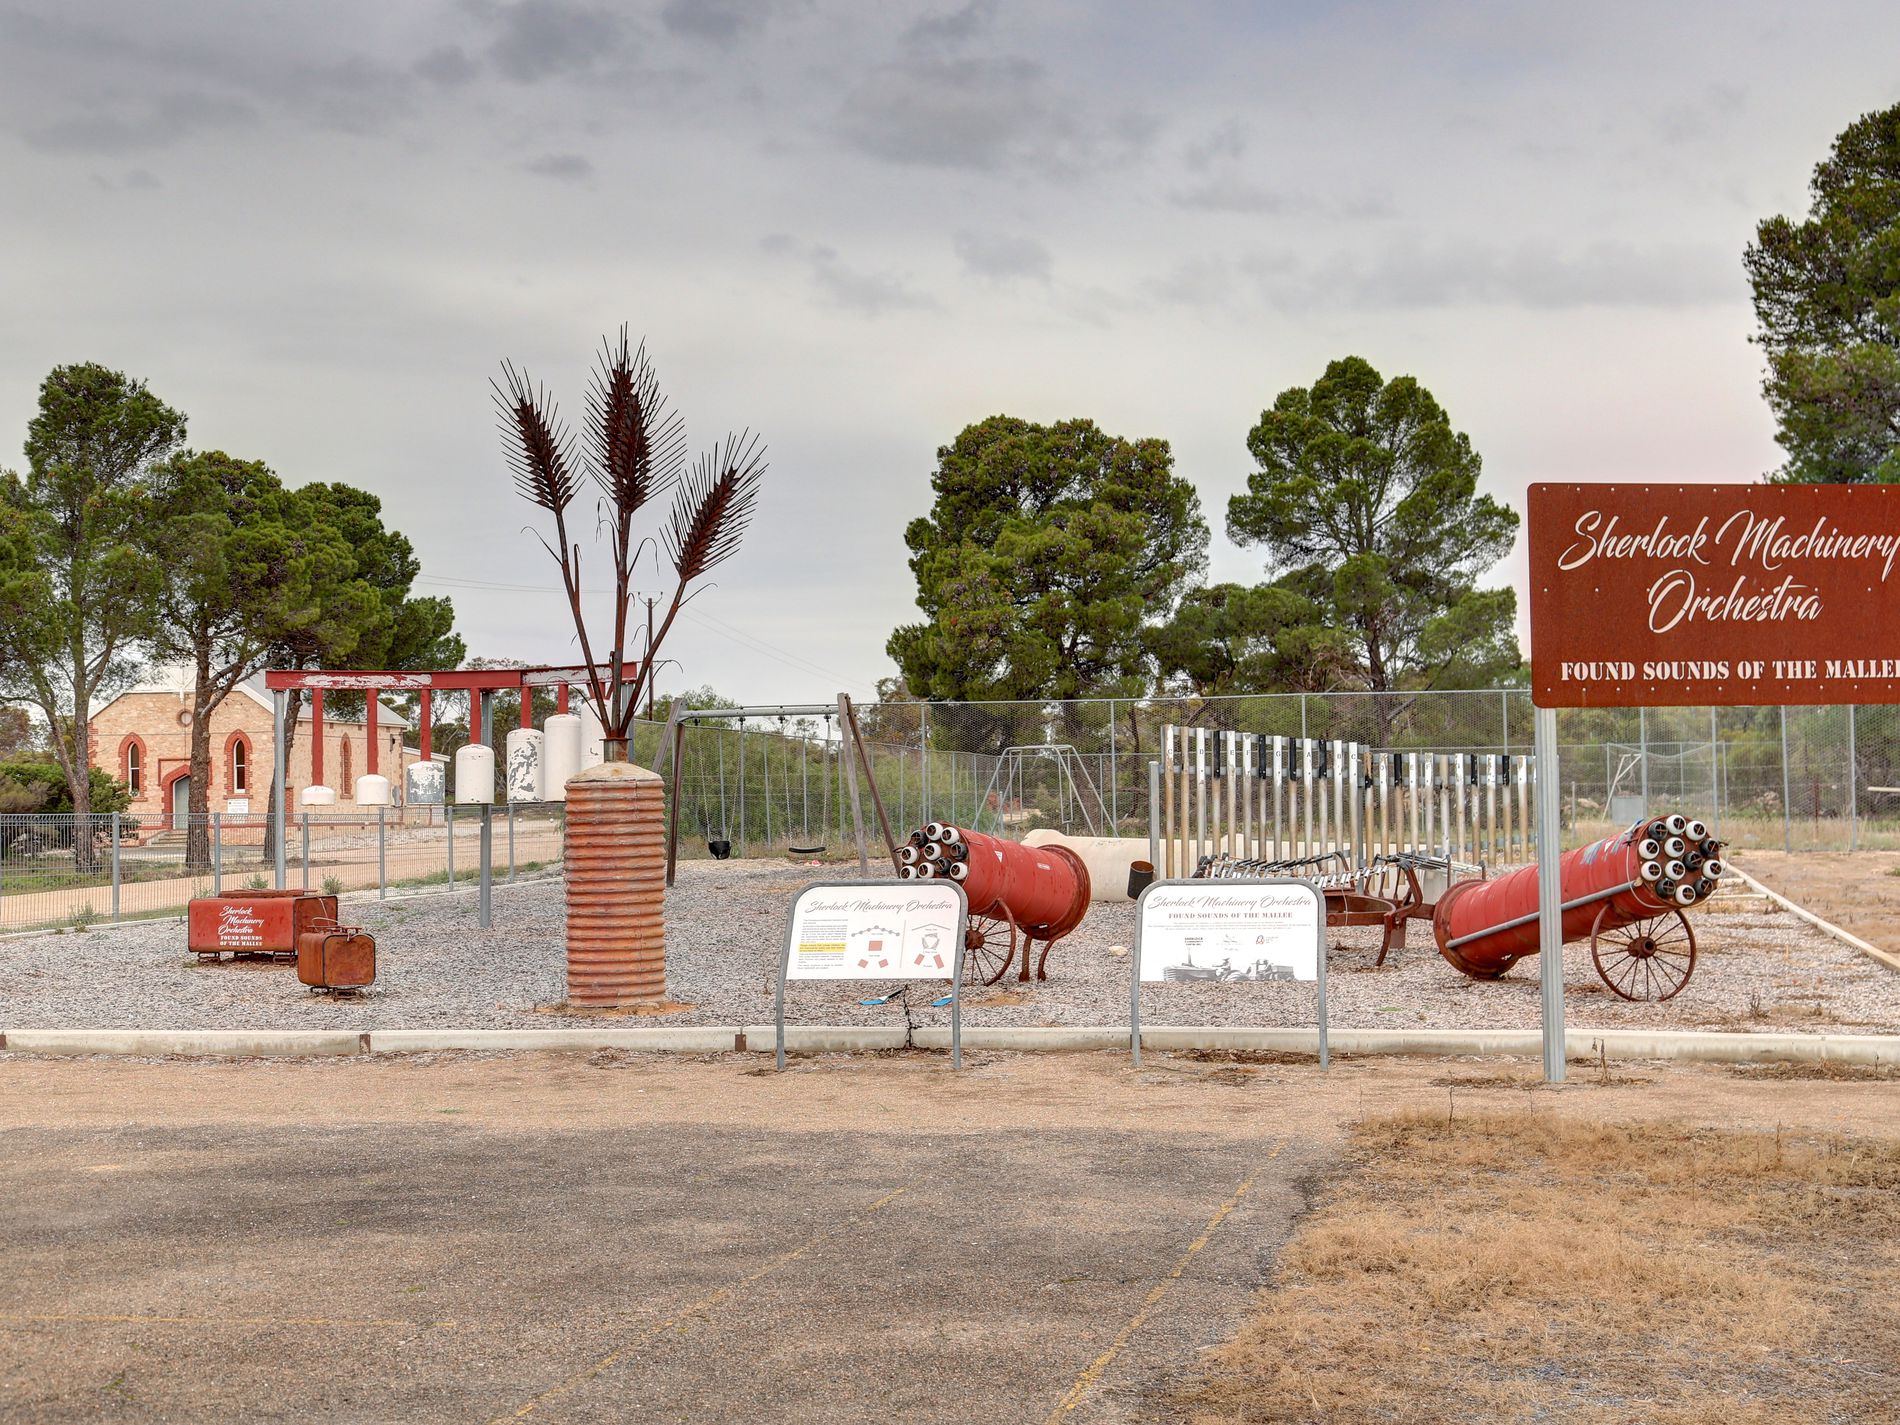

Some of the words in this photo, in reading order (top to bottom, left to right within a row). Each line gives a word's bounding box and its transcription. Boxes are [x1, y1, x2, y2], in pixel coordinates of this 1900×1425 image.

[1557, 510, 1711, 571] Sherlock
[1715, 509, 1900, 582] Machinery
[1648, 569, 1824, 634] Orchestra
[1560, 661, 1636, 681] FOUND
[1642, 660, 1730, 680] SOUNDS
[1737, 660, 1765, 680] OF
[1772, 659, 1817, 679] THE
[219, 905, 253, 916] Sherlock
[804, 900, 849, 914] Sherlock
[850, 899, 905, 915] Machinery
[905, 899, 953, 913] Orchestra
[1147, 895, 1195, 909] Sherlock
[1197, 895, 1258, 911] Machinery
[1260, 894, 1312, 909] Orchestra
[222, 914, 265, 928] Machinery
[217, 925, 253, 935] Orchestra
